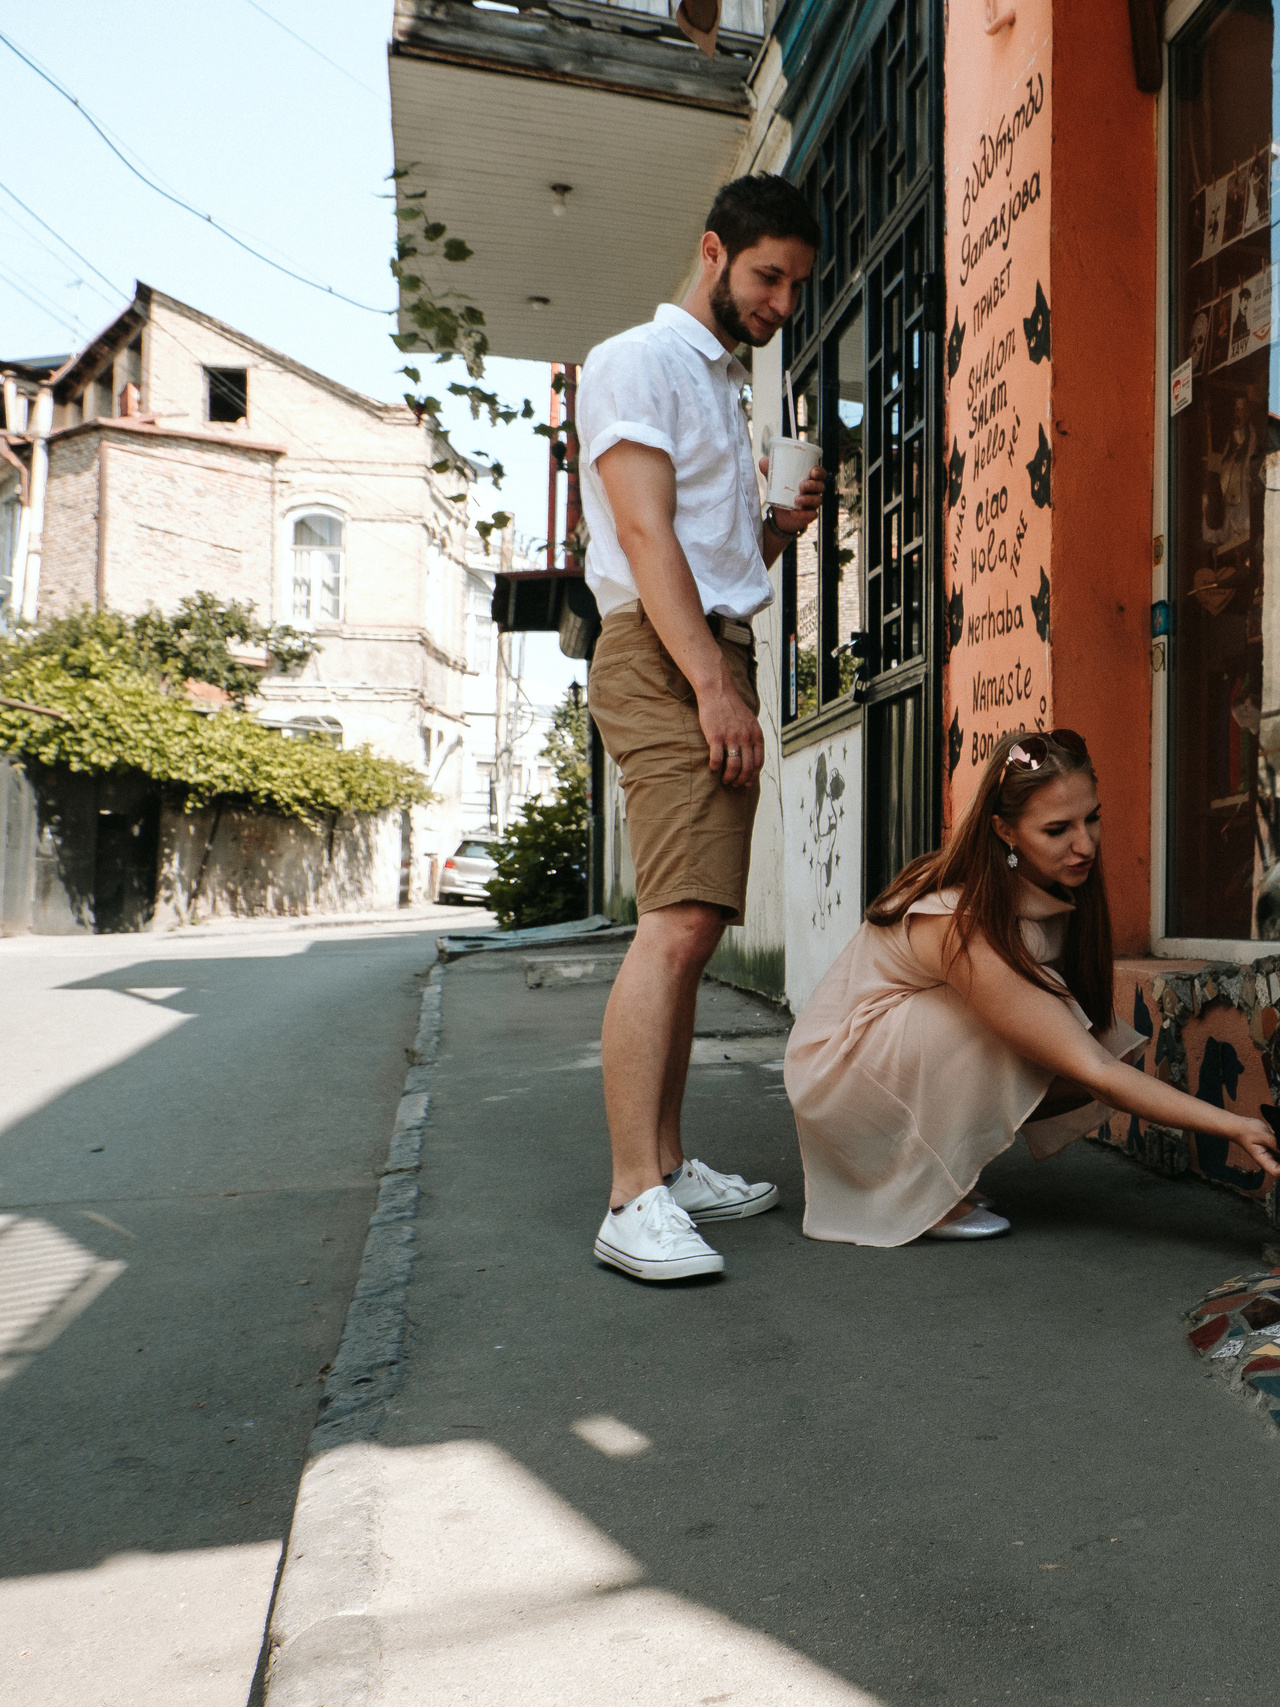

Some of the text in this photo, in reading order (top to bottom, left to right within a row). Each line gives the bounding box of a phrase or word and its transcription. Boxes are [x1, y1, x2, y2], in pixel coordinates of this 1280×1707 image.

[973, 257, 1012, 337] ПРИВЕТ
[973, 423, 1006, 482] Hello
[971, 528, 1008, 586] Hola
[968, 589, 1024, 647] Merhaba
